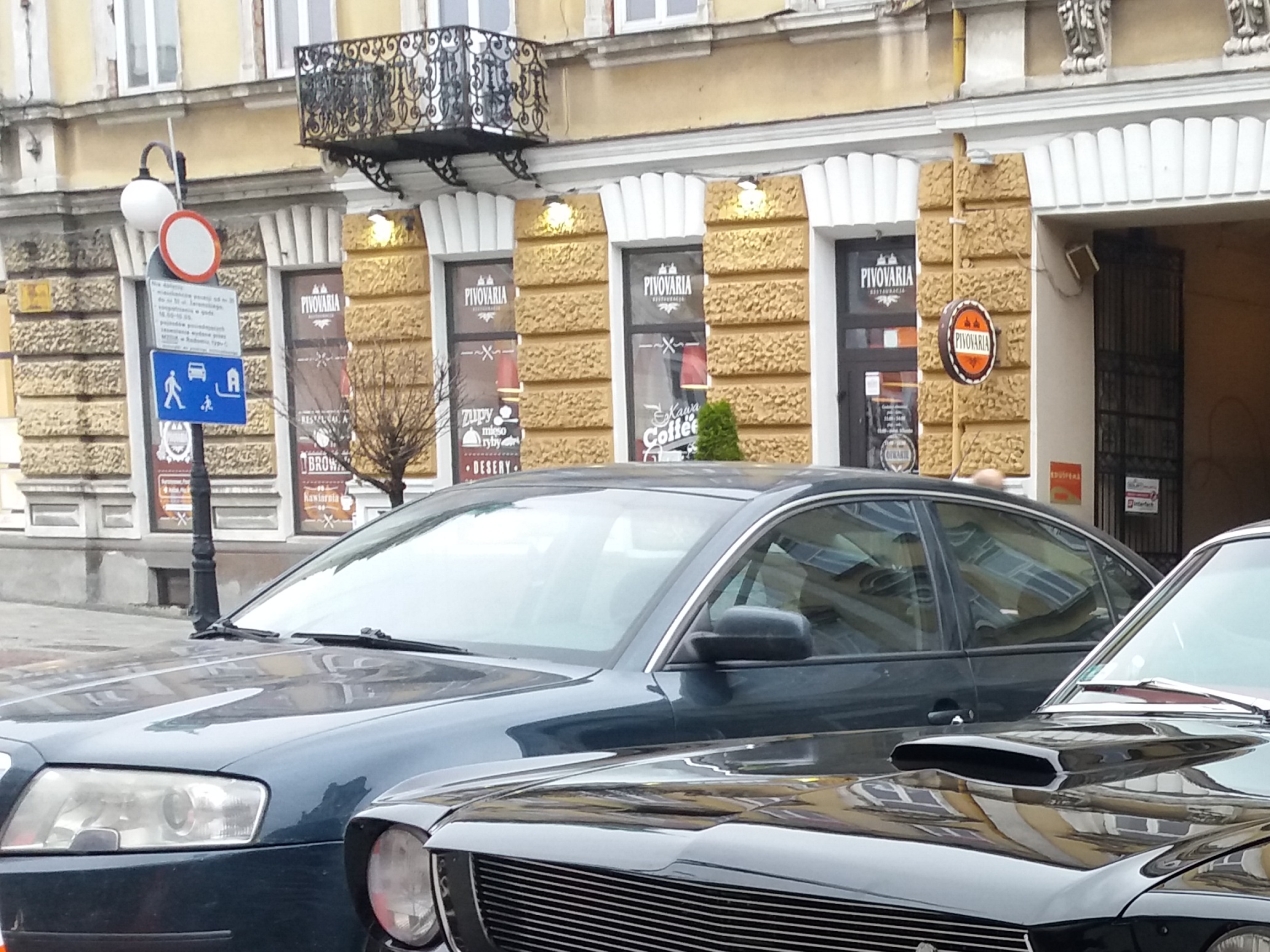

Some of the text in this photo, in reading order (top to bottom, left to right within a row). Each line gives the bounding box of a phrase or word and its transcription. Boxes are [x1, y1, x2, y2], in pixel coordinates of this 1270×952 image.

[643, 275, 692, 297] PIVOVARIA
[860, 265, 914, 289] PIVOVARIA
[301, 293, 341, 314] PIVOVARIA
[464, 286, 508, 307] PIVOVARIA
[955, 332, 990, 352] PIVOVARIA
[668, 402, 701, 420] Kawa
[482, 436, 502, 450] ryby
[473, 460, 511, 475] DESERY
